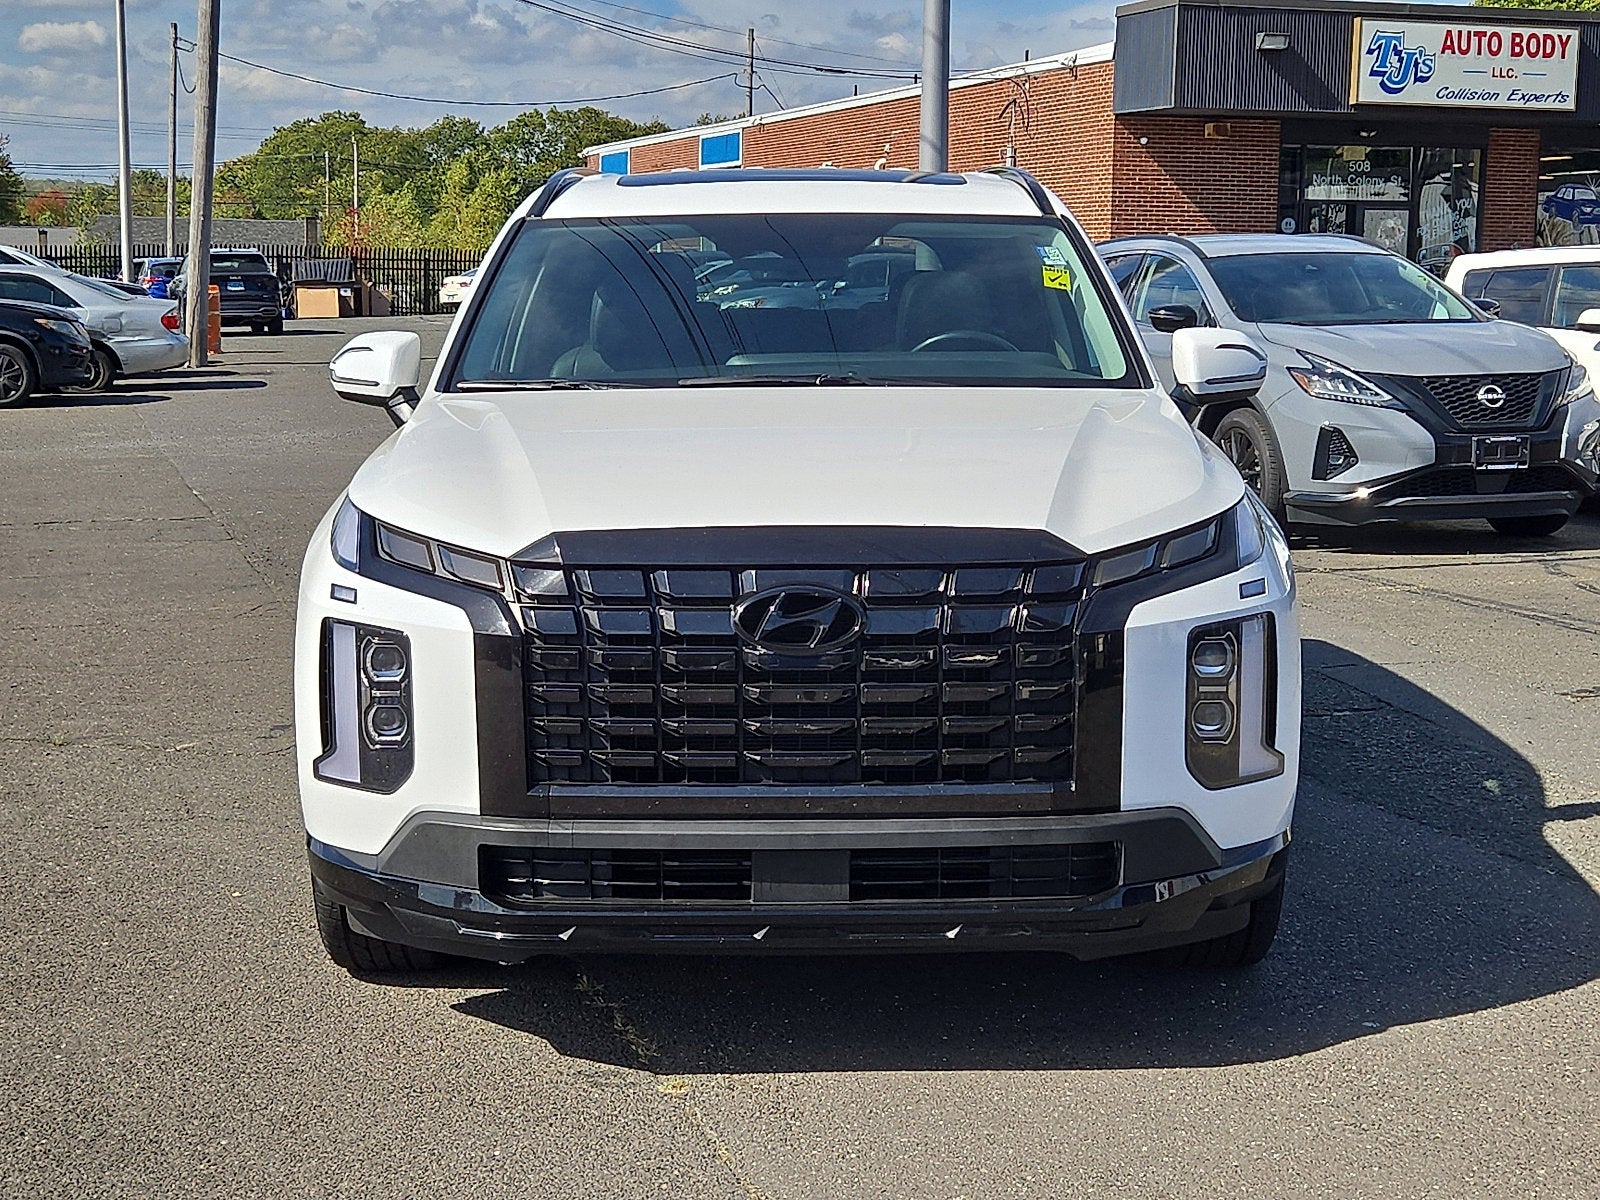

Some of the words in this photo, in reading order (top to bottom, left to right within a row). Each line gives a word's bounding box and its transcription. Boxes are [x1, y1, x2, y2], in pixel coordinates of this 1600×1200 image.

[1441, 29, 1502, 57] AUTO
[1510, 32, 1573, 60] BODY
[1366, 29, 1436, 95] TJ's
[1491, 67, 1518, 79] LLC.
[1436, 86, 1500, 102] Collision
[1507, 89, 1570, 105] Experts
[1349, 161, 1371, 172] 508
[1312, 173, 1342, 185] North
[1347, 174, 1385, 187] Colony
[1390, 175, 1405, 186] St.
